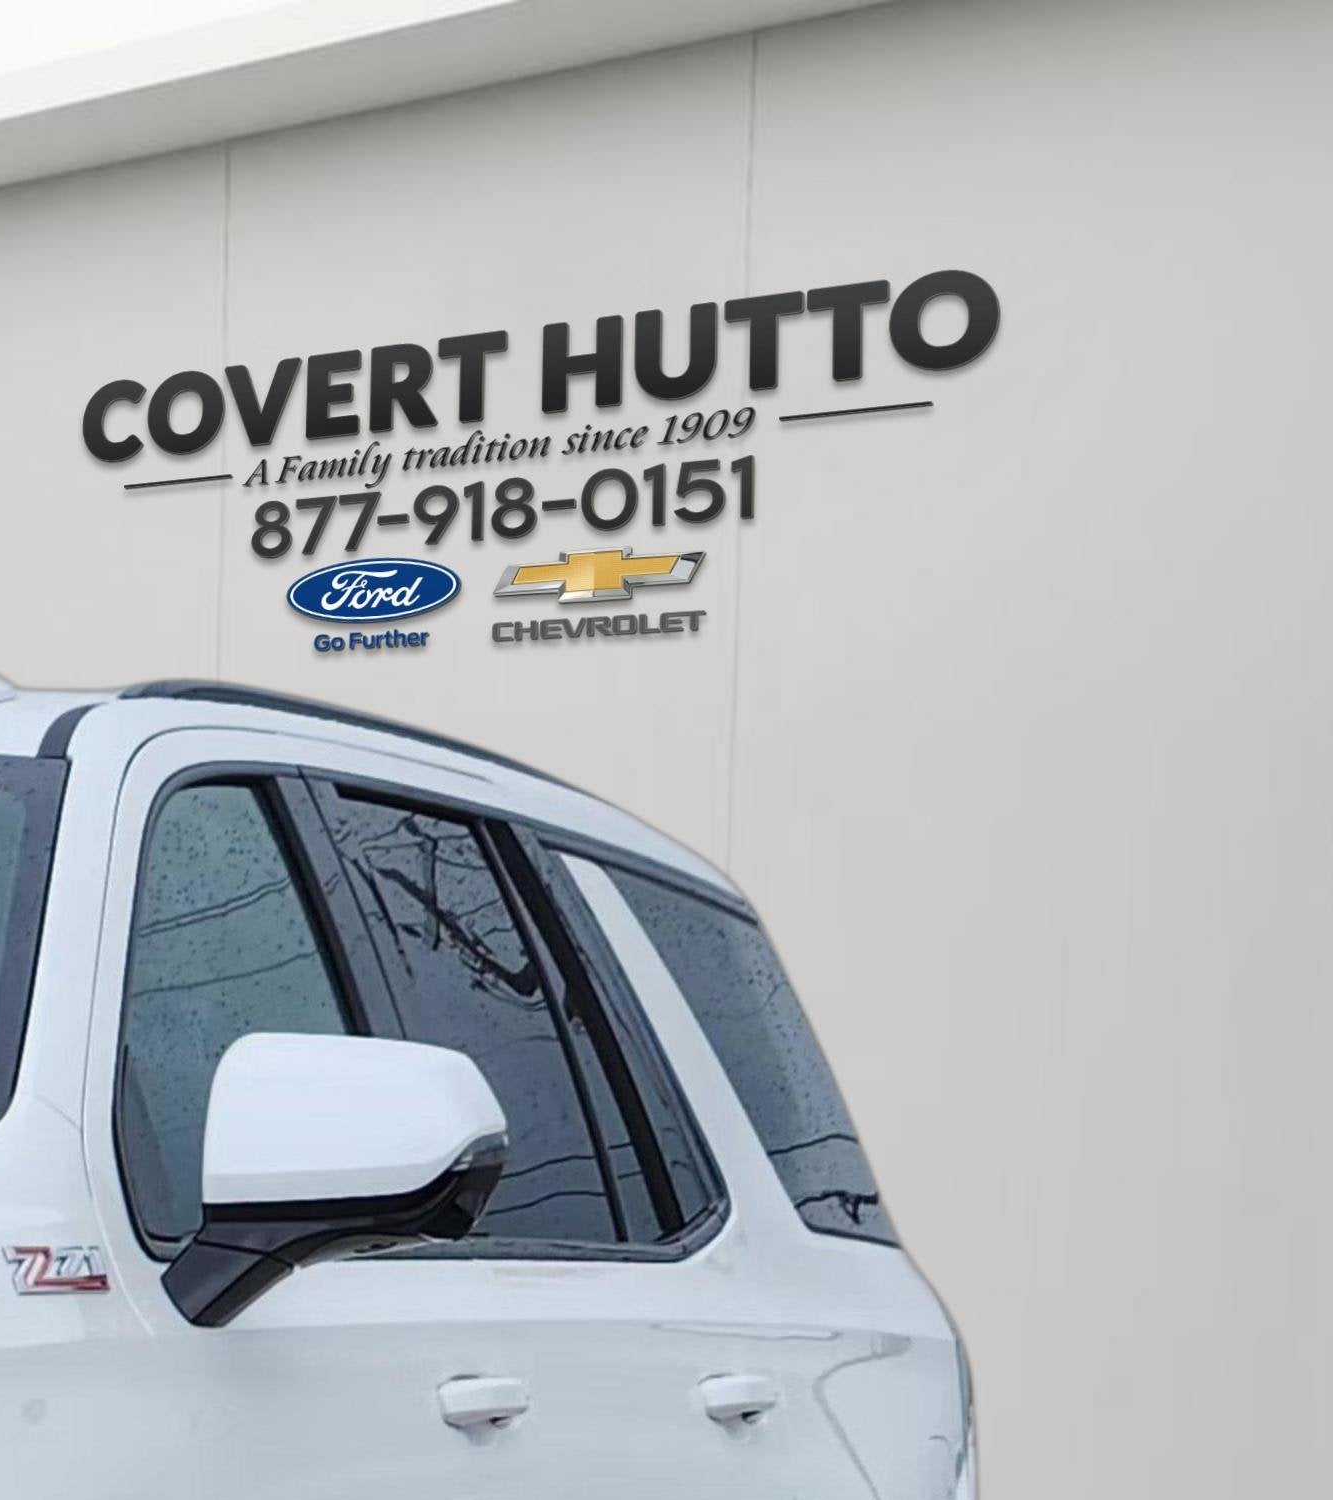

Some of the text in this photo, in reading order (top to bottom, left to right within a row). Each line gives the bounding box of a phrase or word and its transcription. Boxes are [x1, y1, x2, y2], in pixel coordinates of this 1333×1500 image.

[82, 269, 1001, 463] COVERT HUTTO
[243, 406, 757, 488] A Family tradition since 1909
[250, 454, 756, 559] 877-918-0151
[320, 569, 421, 611] Ford
[313, 629, 430, 653] Go Further
[491, 609, 708, 643] CHEVROLET
